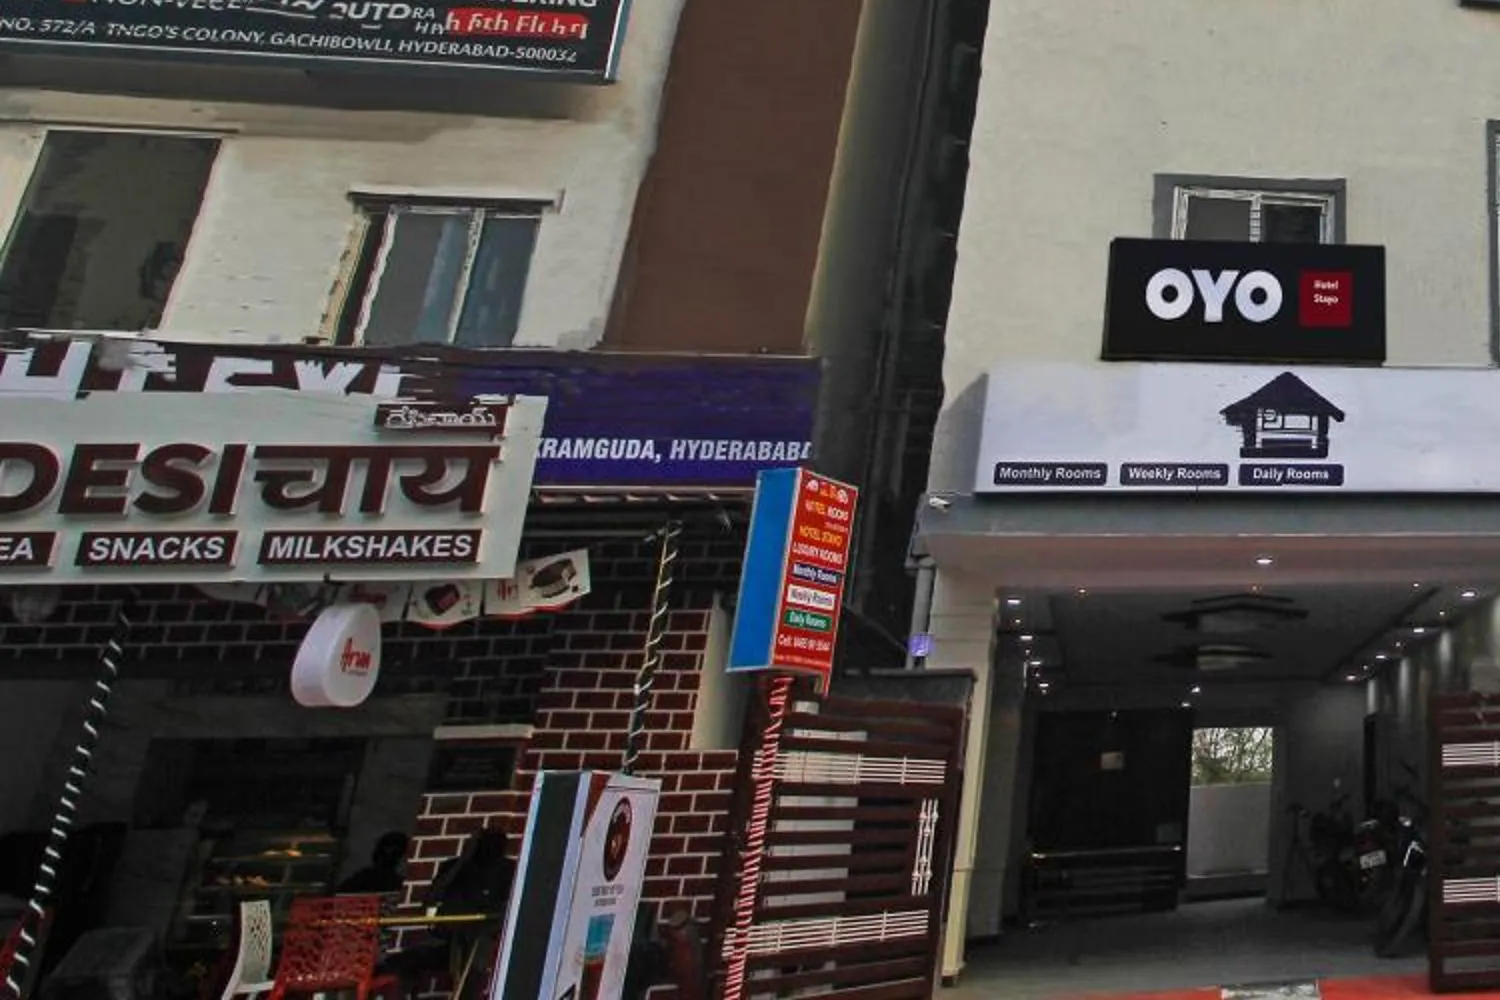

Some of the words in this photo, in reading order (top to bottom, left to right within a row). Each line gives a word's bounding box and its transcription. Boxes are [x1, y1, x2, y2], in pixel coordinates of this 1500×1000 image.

[1145, 267, 1283, 323] OYO
[0, 442, 250, 517] DESI
[253, 444, 503, 515] चाय
[999, 466, 1052, 482] Monthly
[1055, 466, 1102, 480] Rooms
[1128, 467, 1175, 483] Weekly
[1177, 467, 1221, 480] Rooms
[1253, 468, 1284, 484] Daily
[1286, 468, 1329, 481] Rooms
[88, 536, 226, 561] SNACKS
[267, 534, 474, 559] MILKSHAKES
